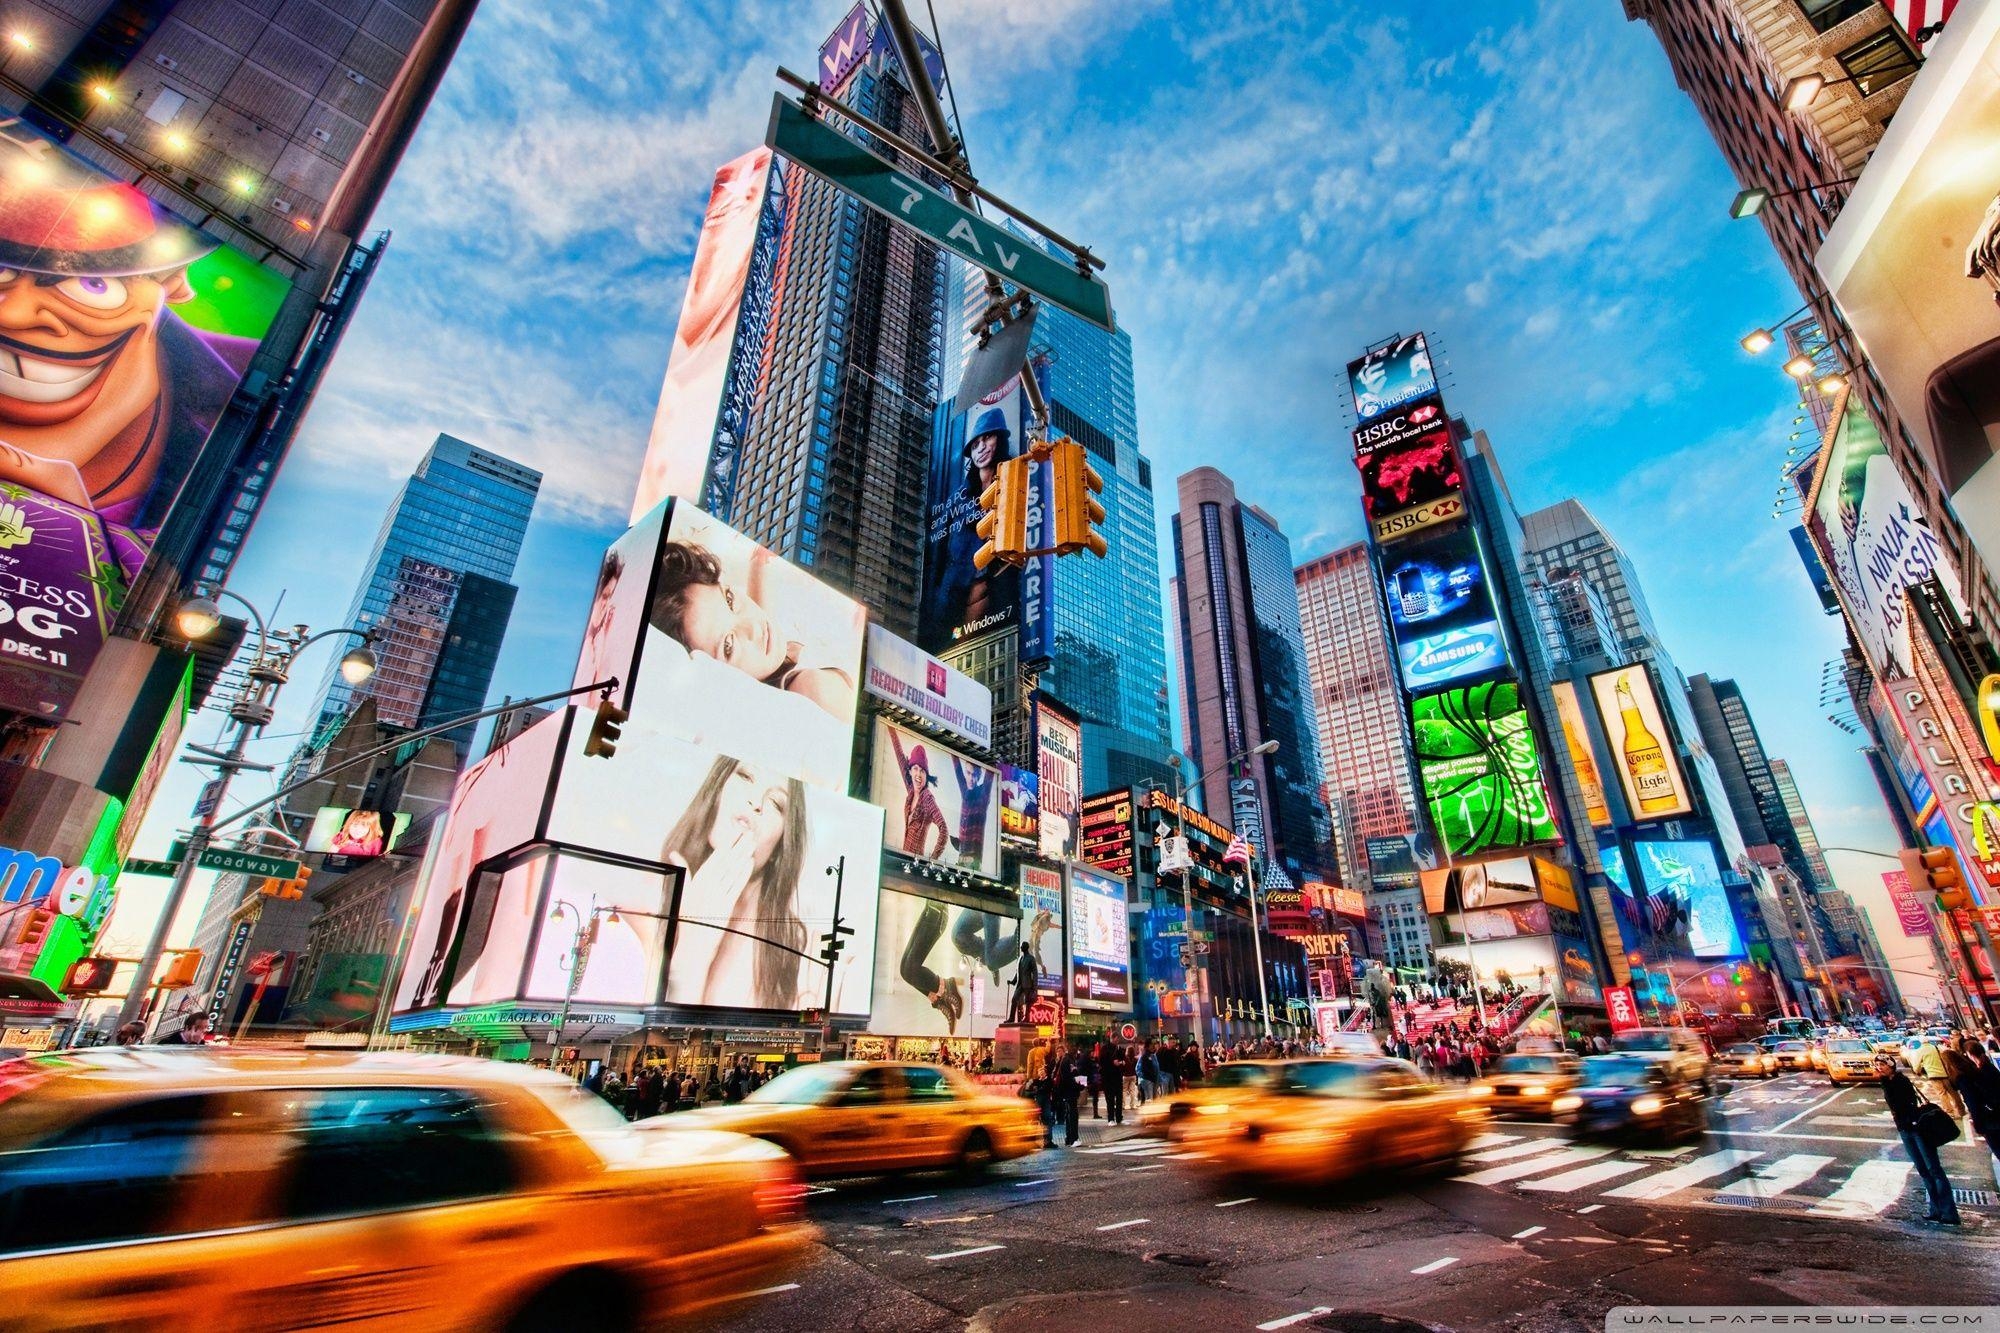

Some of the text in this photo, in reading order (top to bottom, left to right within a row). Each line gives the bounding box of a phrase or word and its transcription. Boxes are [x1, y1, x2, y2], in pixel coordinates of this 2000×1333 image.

[823, 18, 860, 76] W
[890, 176, 1020, 271] 7 AV
[1380, 380, 1435, 409] Prudential
[1356, 416, 1407, 447] HSBC
[1358, 418, 1443, 455] The world's local bank
[954, 487, 967, 504] PC
[931, 496, 981, 530] and Windo
[1377, 508, 1430, 537] HSBC
[930, 528, 948, 543] was
[949, 519, 965, 532] my
[1026, 486, 1043, 624] SQUARE
[1867, 513, 1909, 593] NINJA
[963, 605, 1013, 635] Windows 7
[1, 638, 67, 666] DEC. 11
[1025, 637, 1040, 649] NYC
[1420, 641, 1486, 668] SAMSUNG
[929, 669, 944, 688] GAP
[870, 667, 988, 740] READY FOR HOLIDAY CHEER
[1041, 734, 1077, 764] MUSICAL
[1049, 727, 1069, 747] BEST
[1041, 751, 1066, 789] BILLY
[1422, 755, 1487, 776] display powered
[1436, 769, 1457, 779] wind
[1458, 765, 1487, 777] energy
[1082, 791, 1129, 809] THOMSON REUTERS
[142, 862, 152, 872] 7
[205, 852, 280, 876] roadway
[1026, 868, 1060, 891] HEIGHTS
[1022, 893, 1061, 914] BEST MUSICAL
[1266, 890, 1301, 902] Reese's
[1895, 893, 1915, 901] FREE
[453, 1012, 496, 1023] AMERICAN
[500, 1013, 538, 1023] EAGLE
[1029, 1007, 1055, 1023] ROXY
[1610, 990, 1630, 1022] tkts
